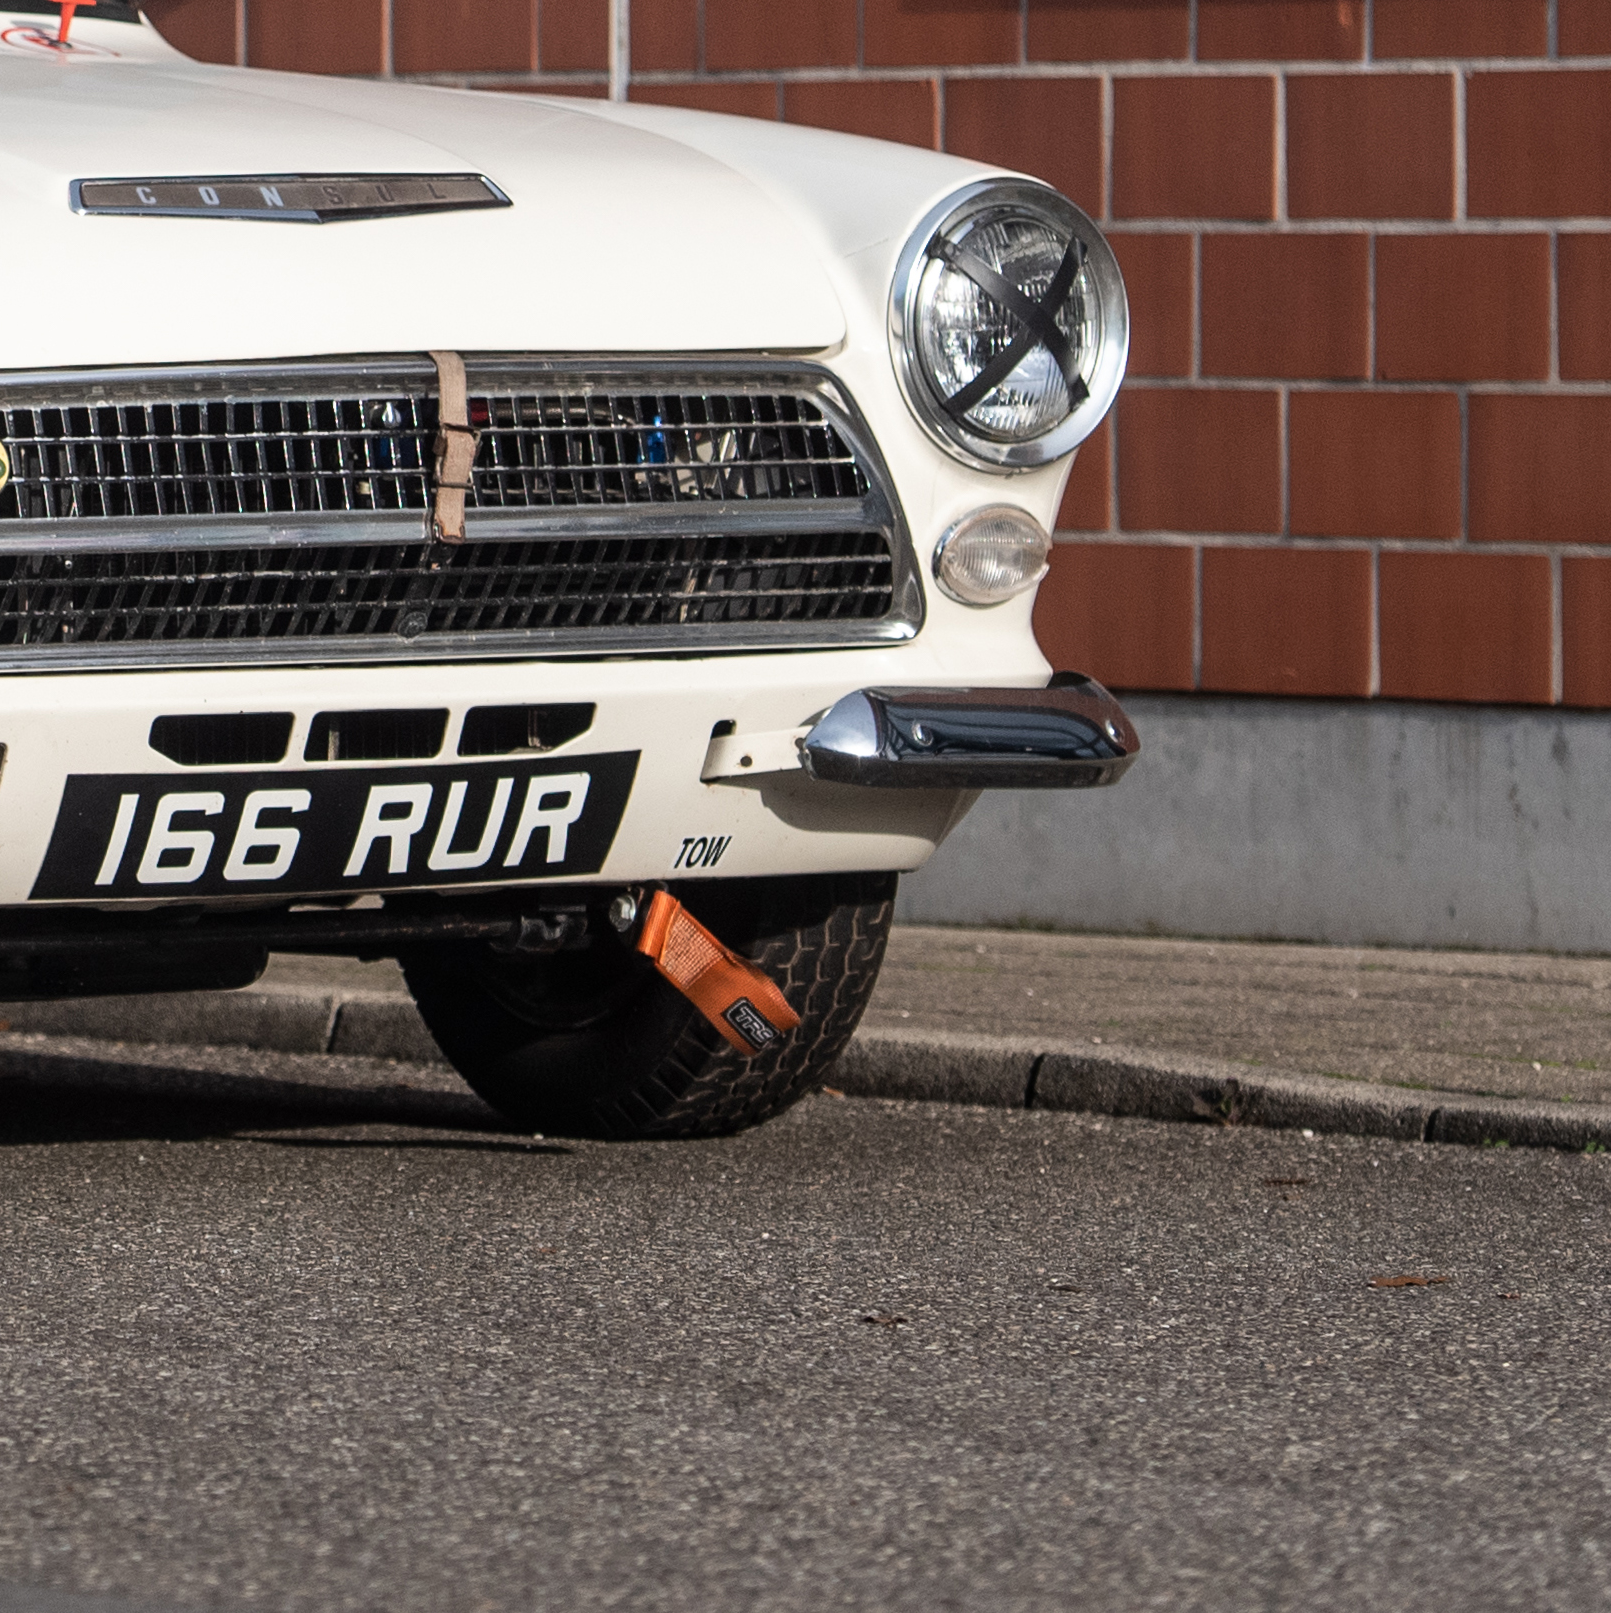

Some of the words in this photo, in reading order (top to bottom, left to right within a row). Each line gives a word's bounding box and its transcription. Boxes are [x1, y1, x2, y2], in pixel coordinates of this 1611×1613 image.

[135, 182, 448, 208] CONSUL
[94, 788, 312, 884] 166
[342, 771, 591, 877] RUR
[673, 835, 733, 869] TOW
[734, 1006, 774, 1044] TRS
